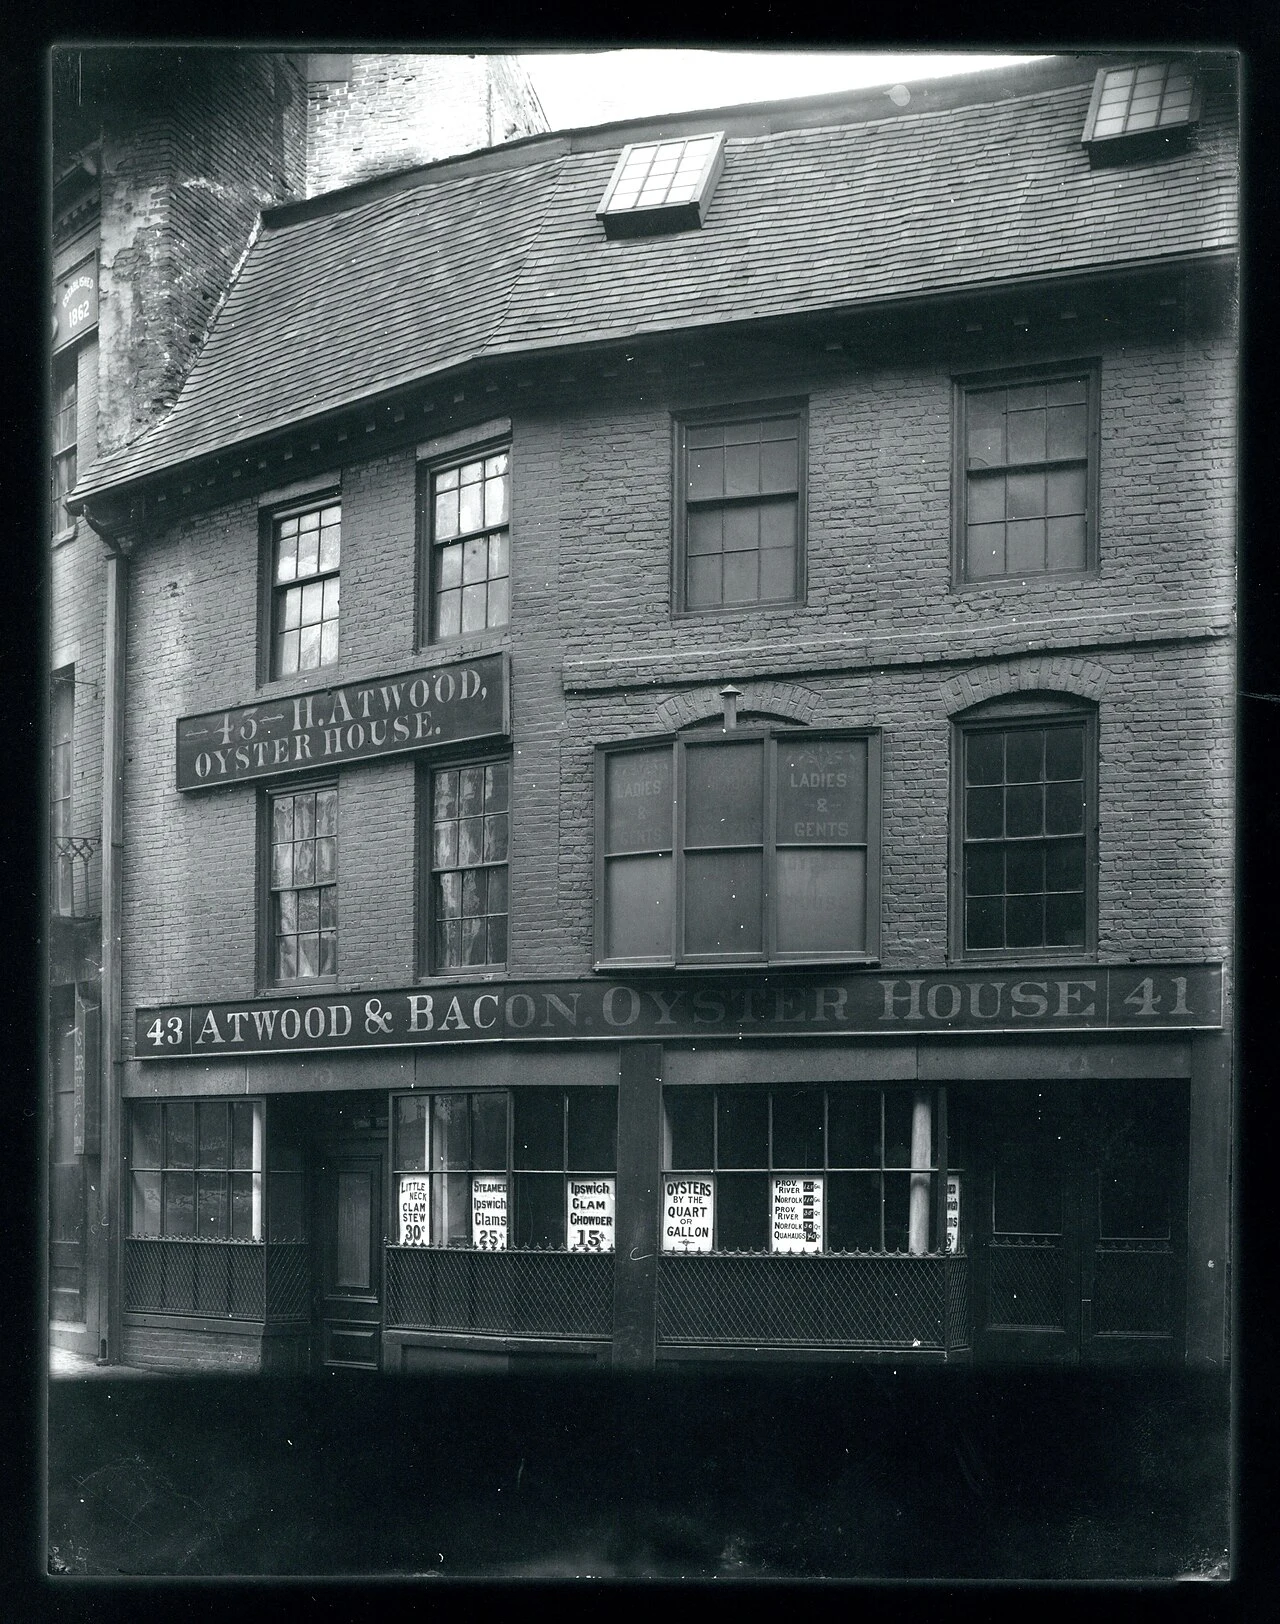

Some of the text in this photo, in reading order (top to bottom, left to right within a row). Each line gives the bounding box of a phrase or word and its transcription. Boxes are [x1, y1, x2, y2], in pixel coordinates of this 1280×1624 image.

[69, 300, 90, 328] 1862
[194, 710, 441, 777] OYSTER HOUSE.
[791, 772, 847, 788] LADIES
[617, 781, 661, 799] LADIES
[794, 821, 849, 838] GENTS
[146, 976, 1194, 1047] 43 ATWOOD & BACON. OYSTER HOUSE 41
[401, 1182, 426, 1194] LITTLE
[571, 1182, 609, 1195] Ipswich
[667, 1181, 711, 1196] OYSTERS
[409, 1192, 427, 1202] NECK
[474, 1197, 507, 1210] Ipswich
[673, 1196, 703, 1204] BY THE
[775, 1195, 802, 1203] NORFOLK
[403, 1202, 426, 1212] CLAM
[572, 1198, 605, 1210] CLAM
[403, 1213, 426, 1223] STEW
[668, 1206, 708, 1218] QUART
[475, 1212, 507, 1226] Clams
[570, 1212, 613, 1226] CHOWDER
[667, 1226, 709, 1238] GALLON
